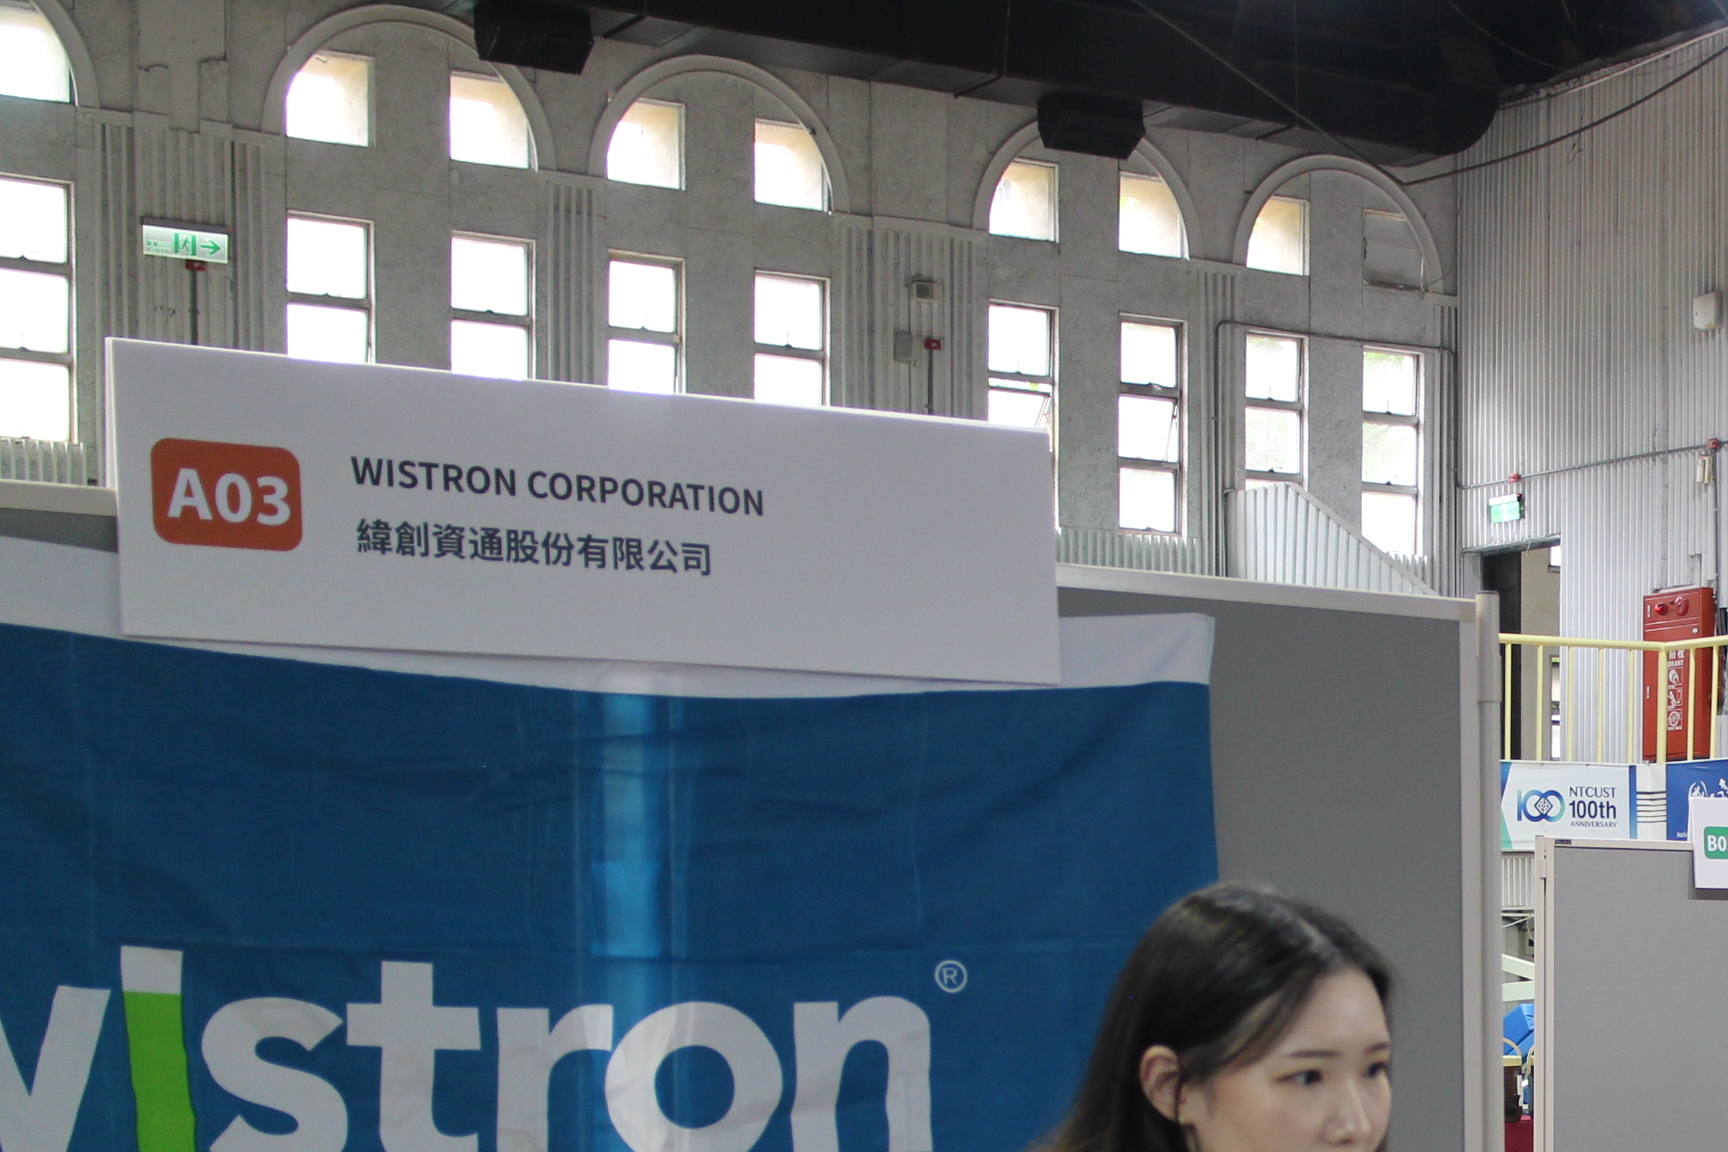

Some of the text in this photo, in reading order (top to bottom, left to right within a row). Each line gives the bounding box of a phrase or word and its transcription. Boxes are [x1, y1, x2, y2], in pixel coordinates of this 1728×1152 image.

[166, 467, 291, 526] A03
[350, 455, 765, 517] WISTRON CORPORATION
[356, 517, 712, 576] 緯創資通股份有限公司
[1569, 786, 1618, 799] NTCUST
[1569, 800, 1617, 819] 100th
[1570, 820, 1618, 829] ANNIVERSARY
